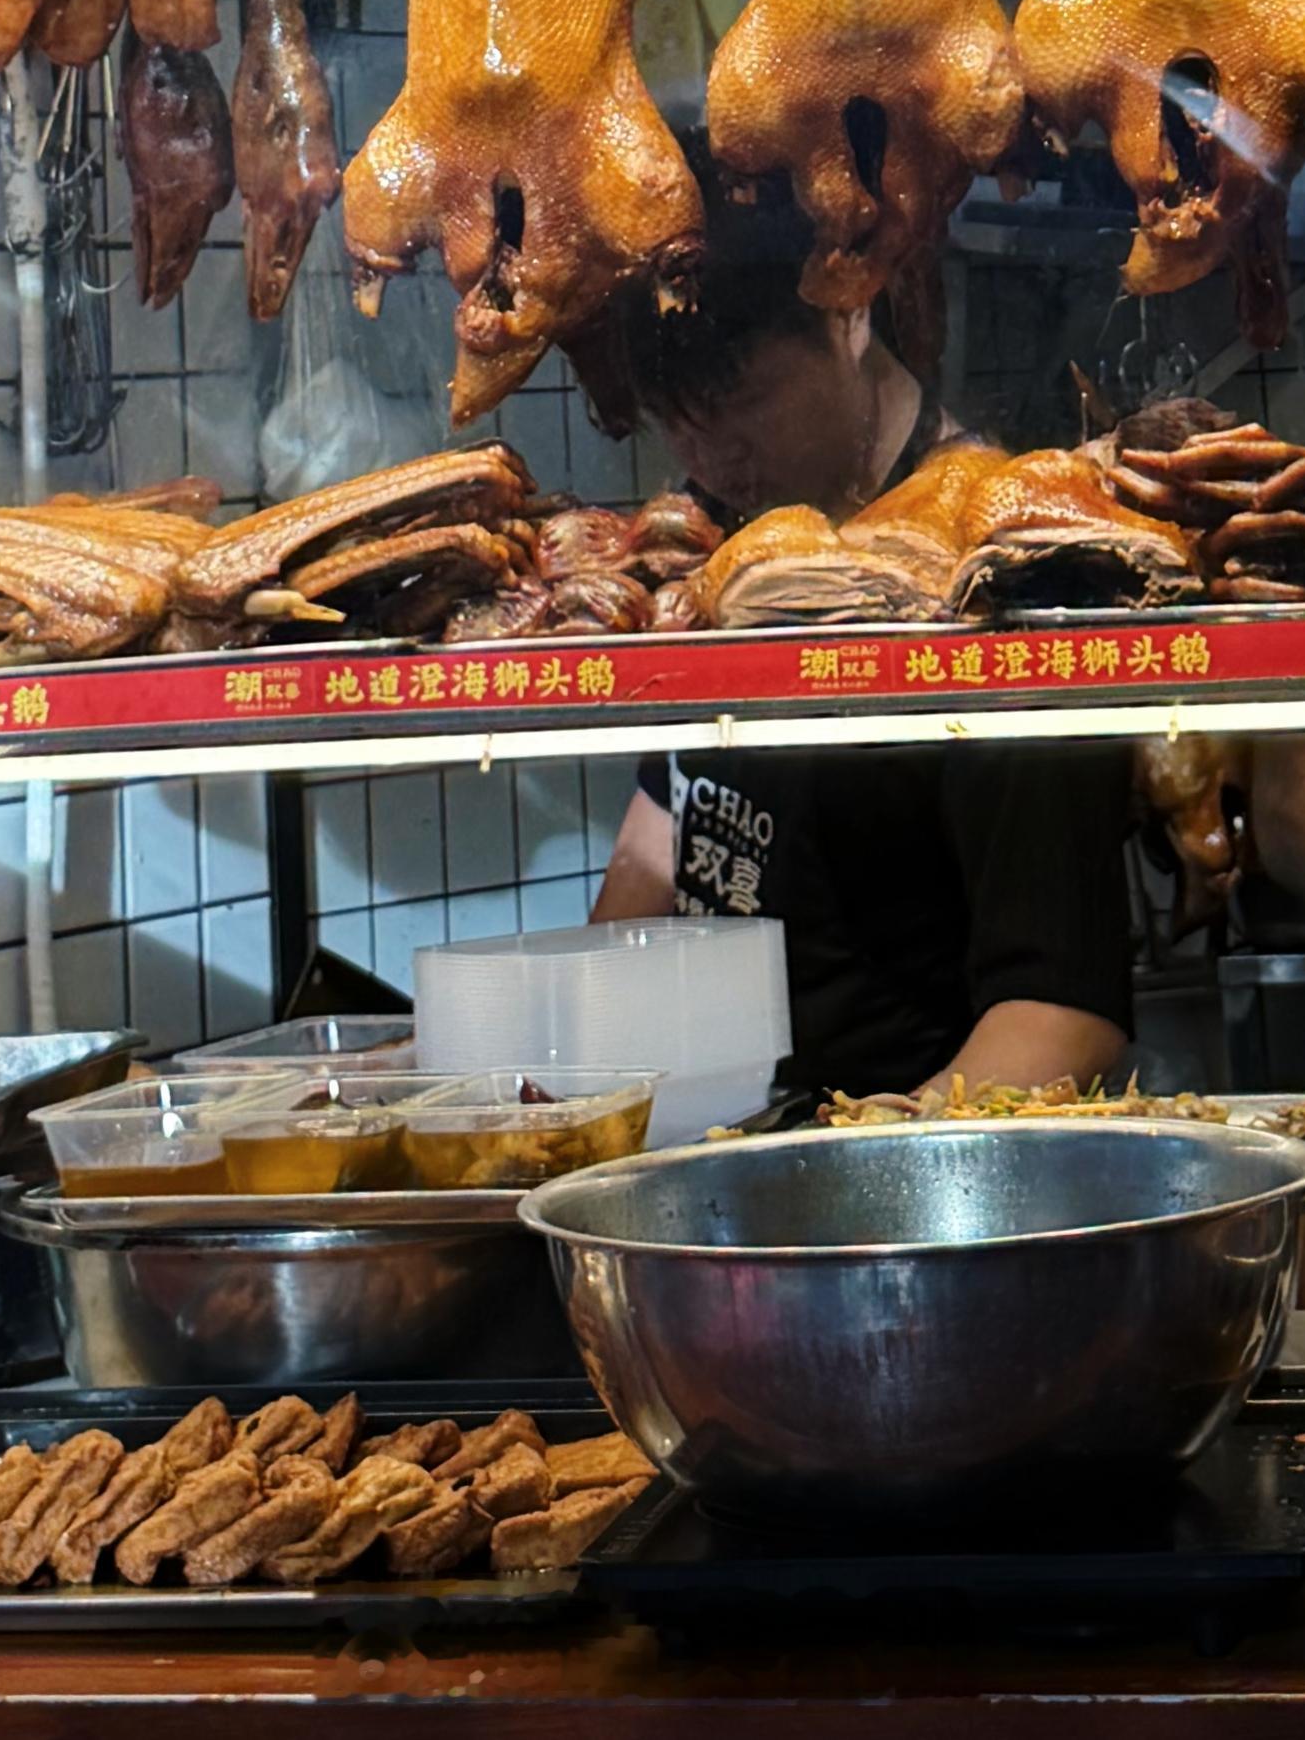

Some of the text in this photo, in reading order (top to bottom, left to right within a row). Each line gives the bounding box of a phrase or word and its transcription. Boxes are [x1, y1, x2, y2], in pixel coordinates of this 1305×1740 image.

[325, 654, 615, 705] 地道澄海狮头鹅
[905, 631, 1212, 683] 地道澄海狮头鹅
[686, 835, 761, 914] 双喜
